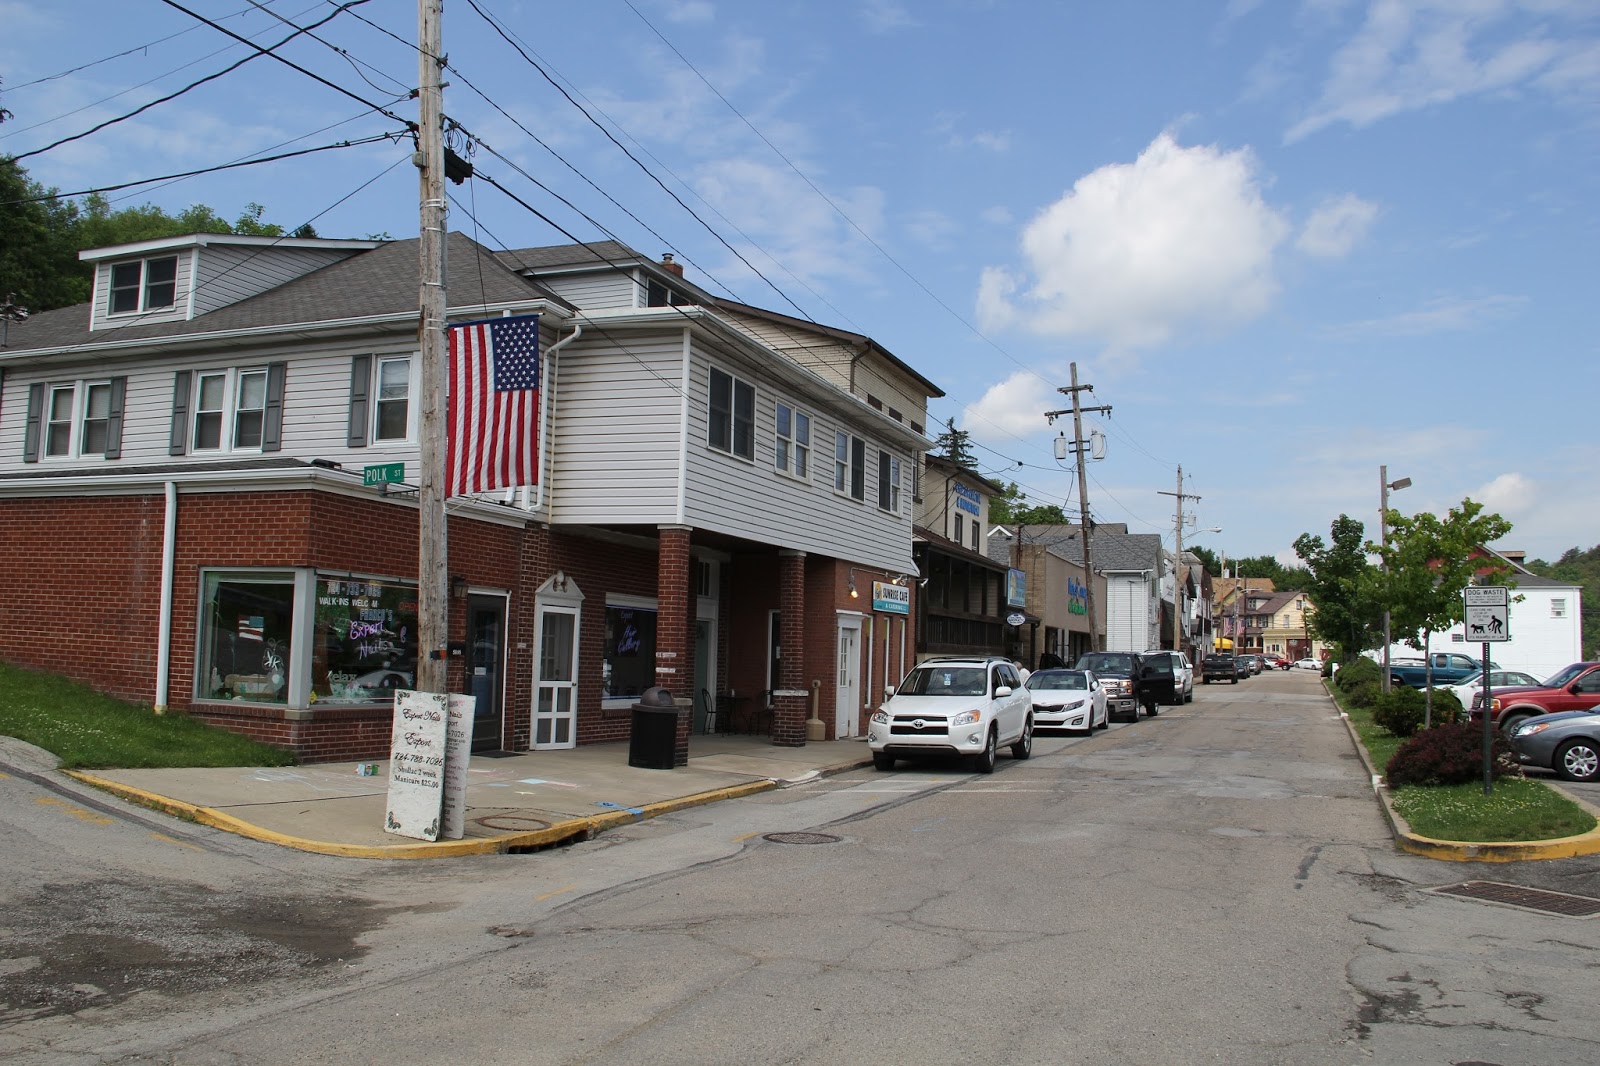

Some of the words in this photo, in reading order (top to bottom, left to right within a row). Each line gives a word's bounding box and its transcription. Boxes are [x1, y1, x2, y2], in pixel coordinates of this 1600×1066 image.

[366, 468, 387, 482] POLK
[394, 469, 401, 477] ST
[883, 587, 899, 600] SUNRISE
[899, 591, 908, 602] CAFE
[423, 710, 441, 721] Nails
